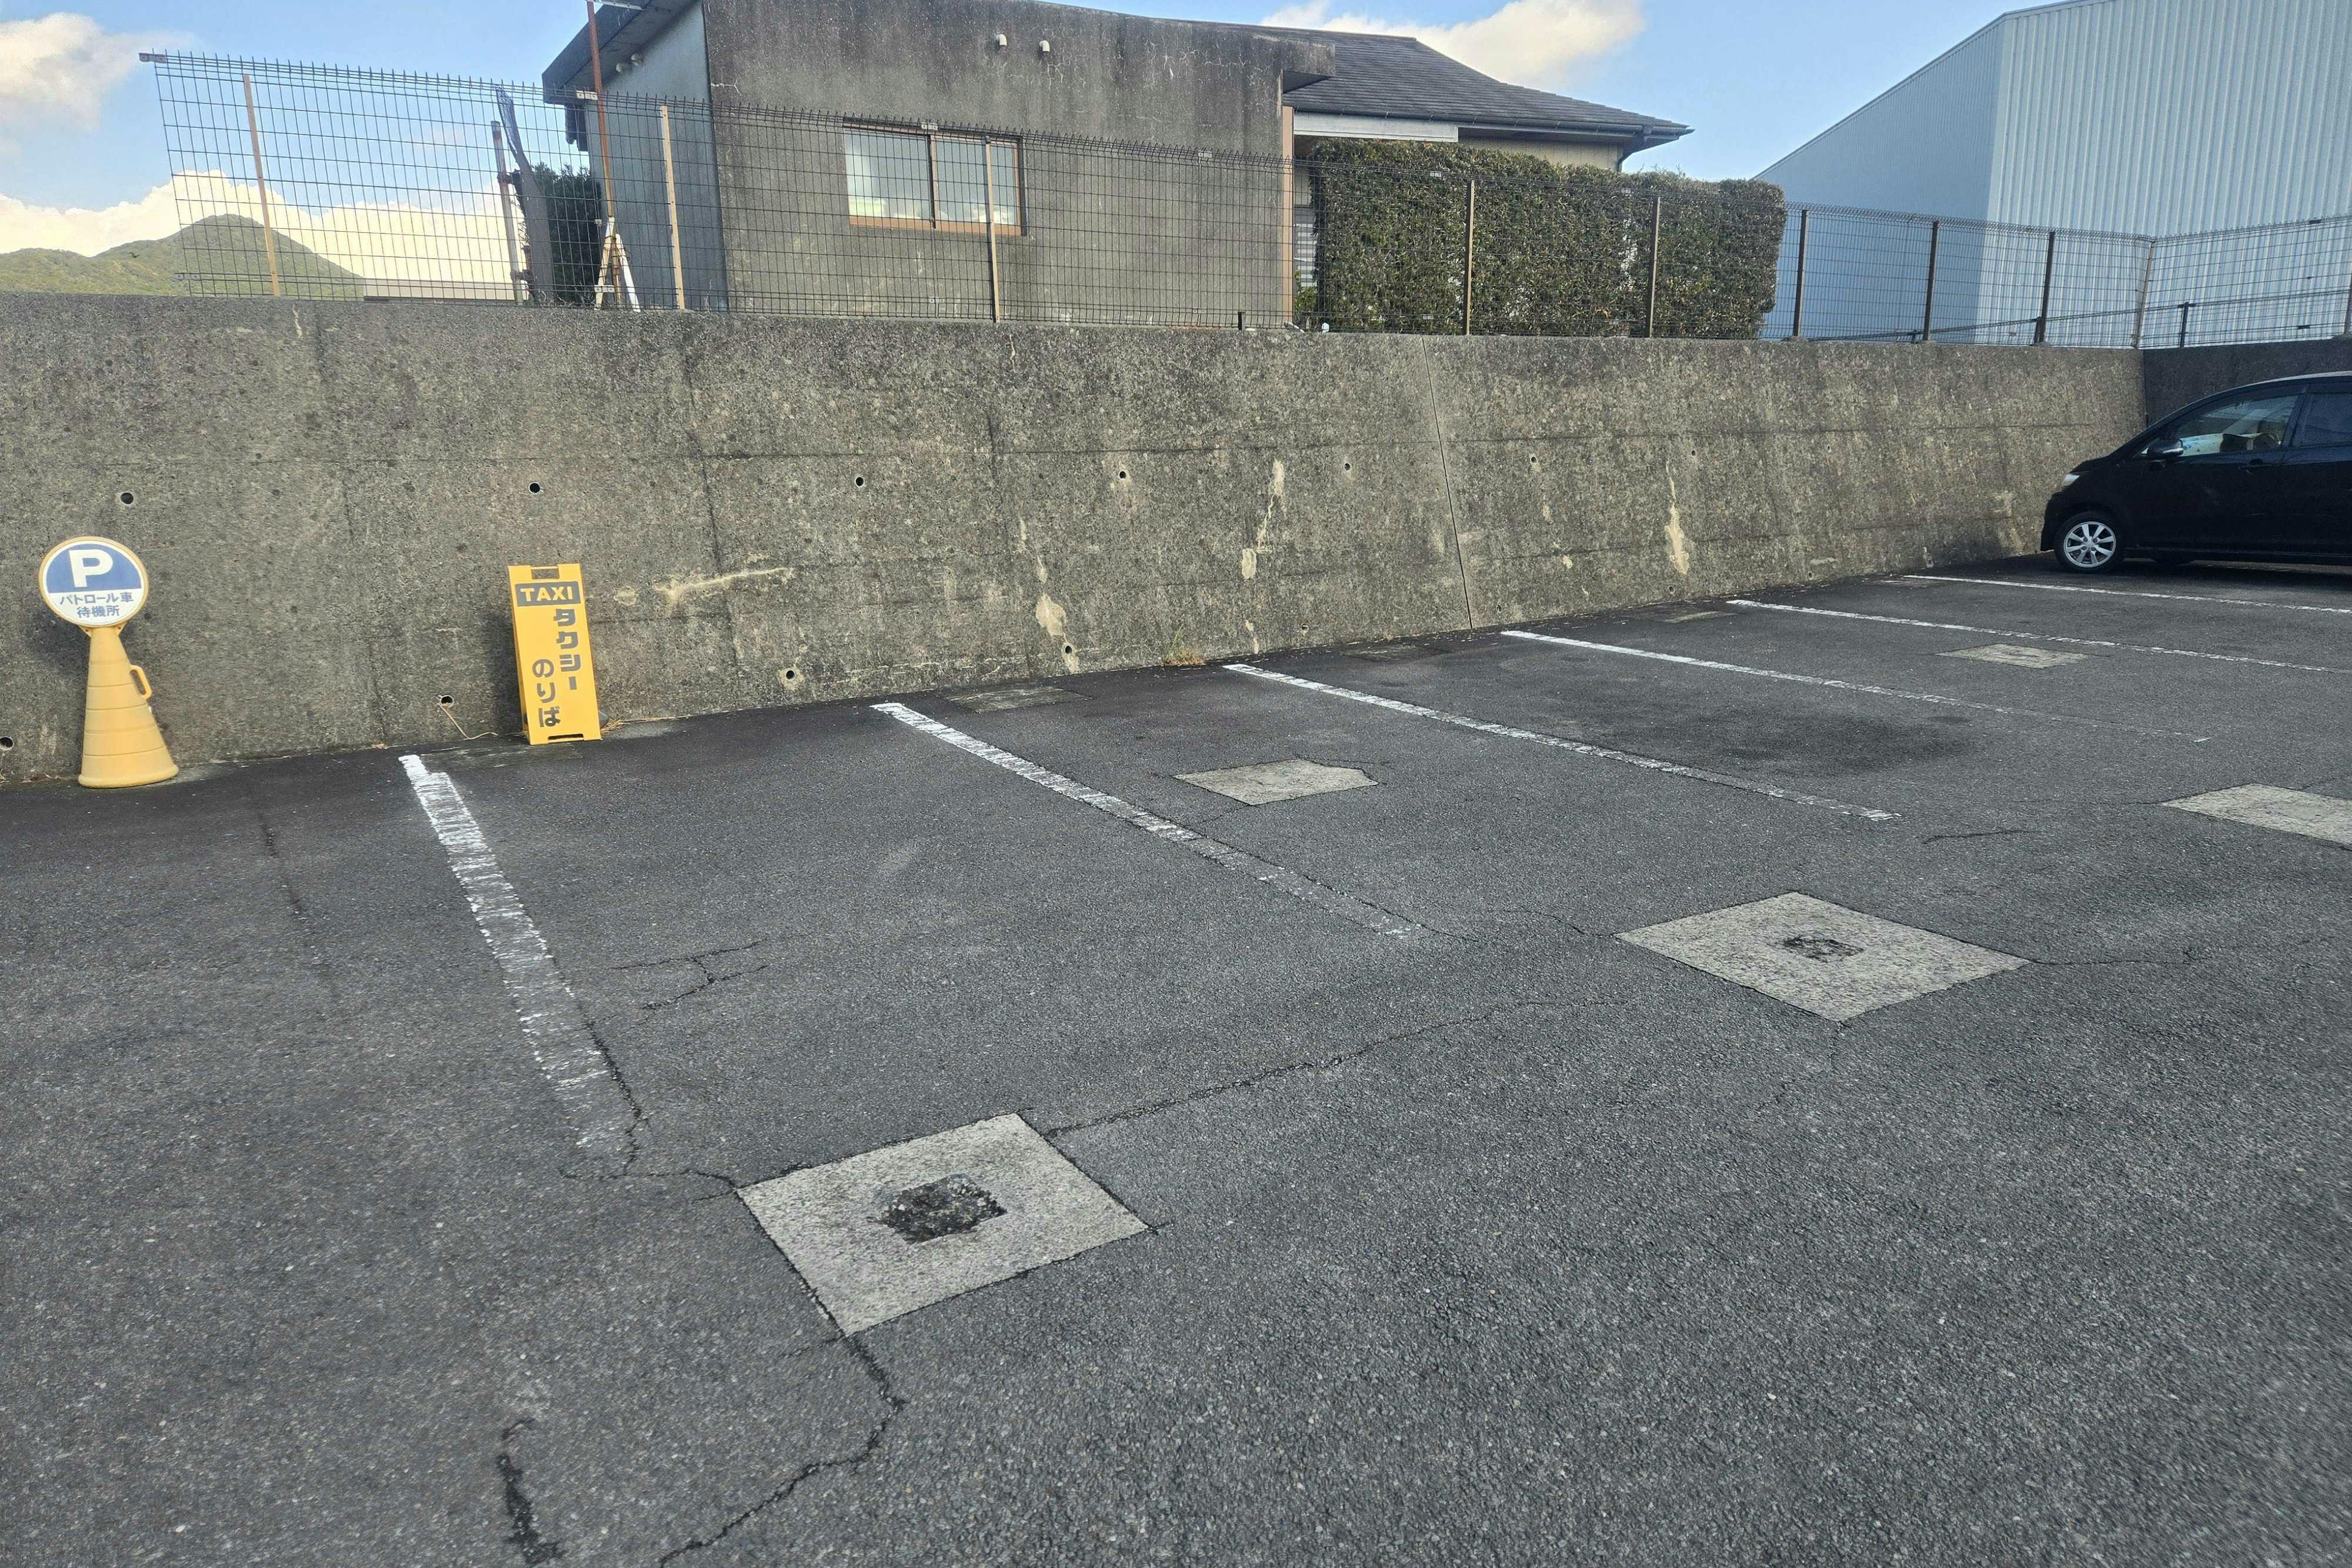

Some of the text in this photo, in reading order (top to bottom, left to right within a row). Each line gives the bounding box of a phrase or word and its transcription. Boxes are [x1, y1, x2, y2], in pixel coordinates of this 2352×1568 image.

[68, 549, 113, 588] P
[60, 592, 134, 605] パトロール車
[520, 586, 573, 602] TAXI
[77, 605, 121, 618] 待機所
[553, 608, 582, 690] タクシー
[532, 658, 561, 728] のりば
